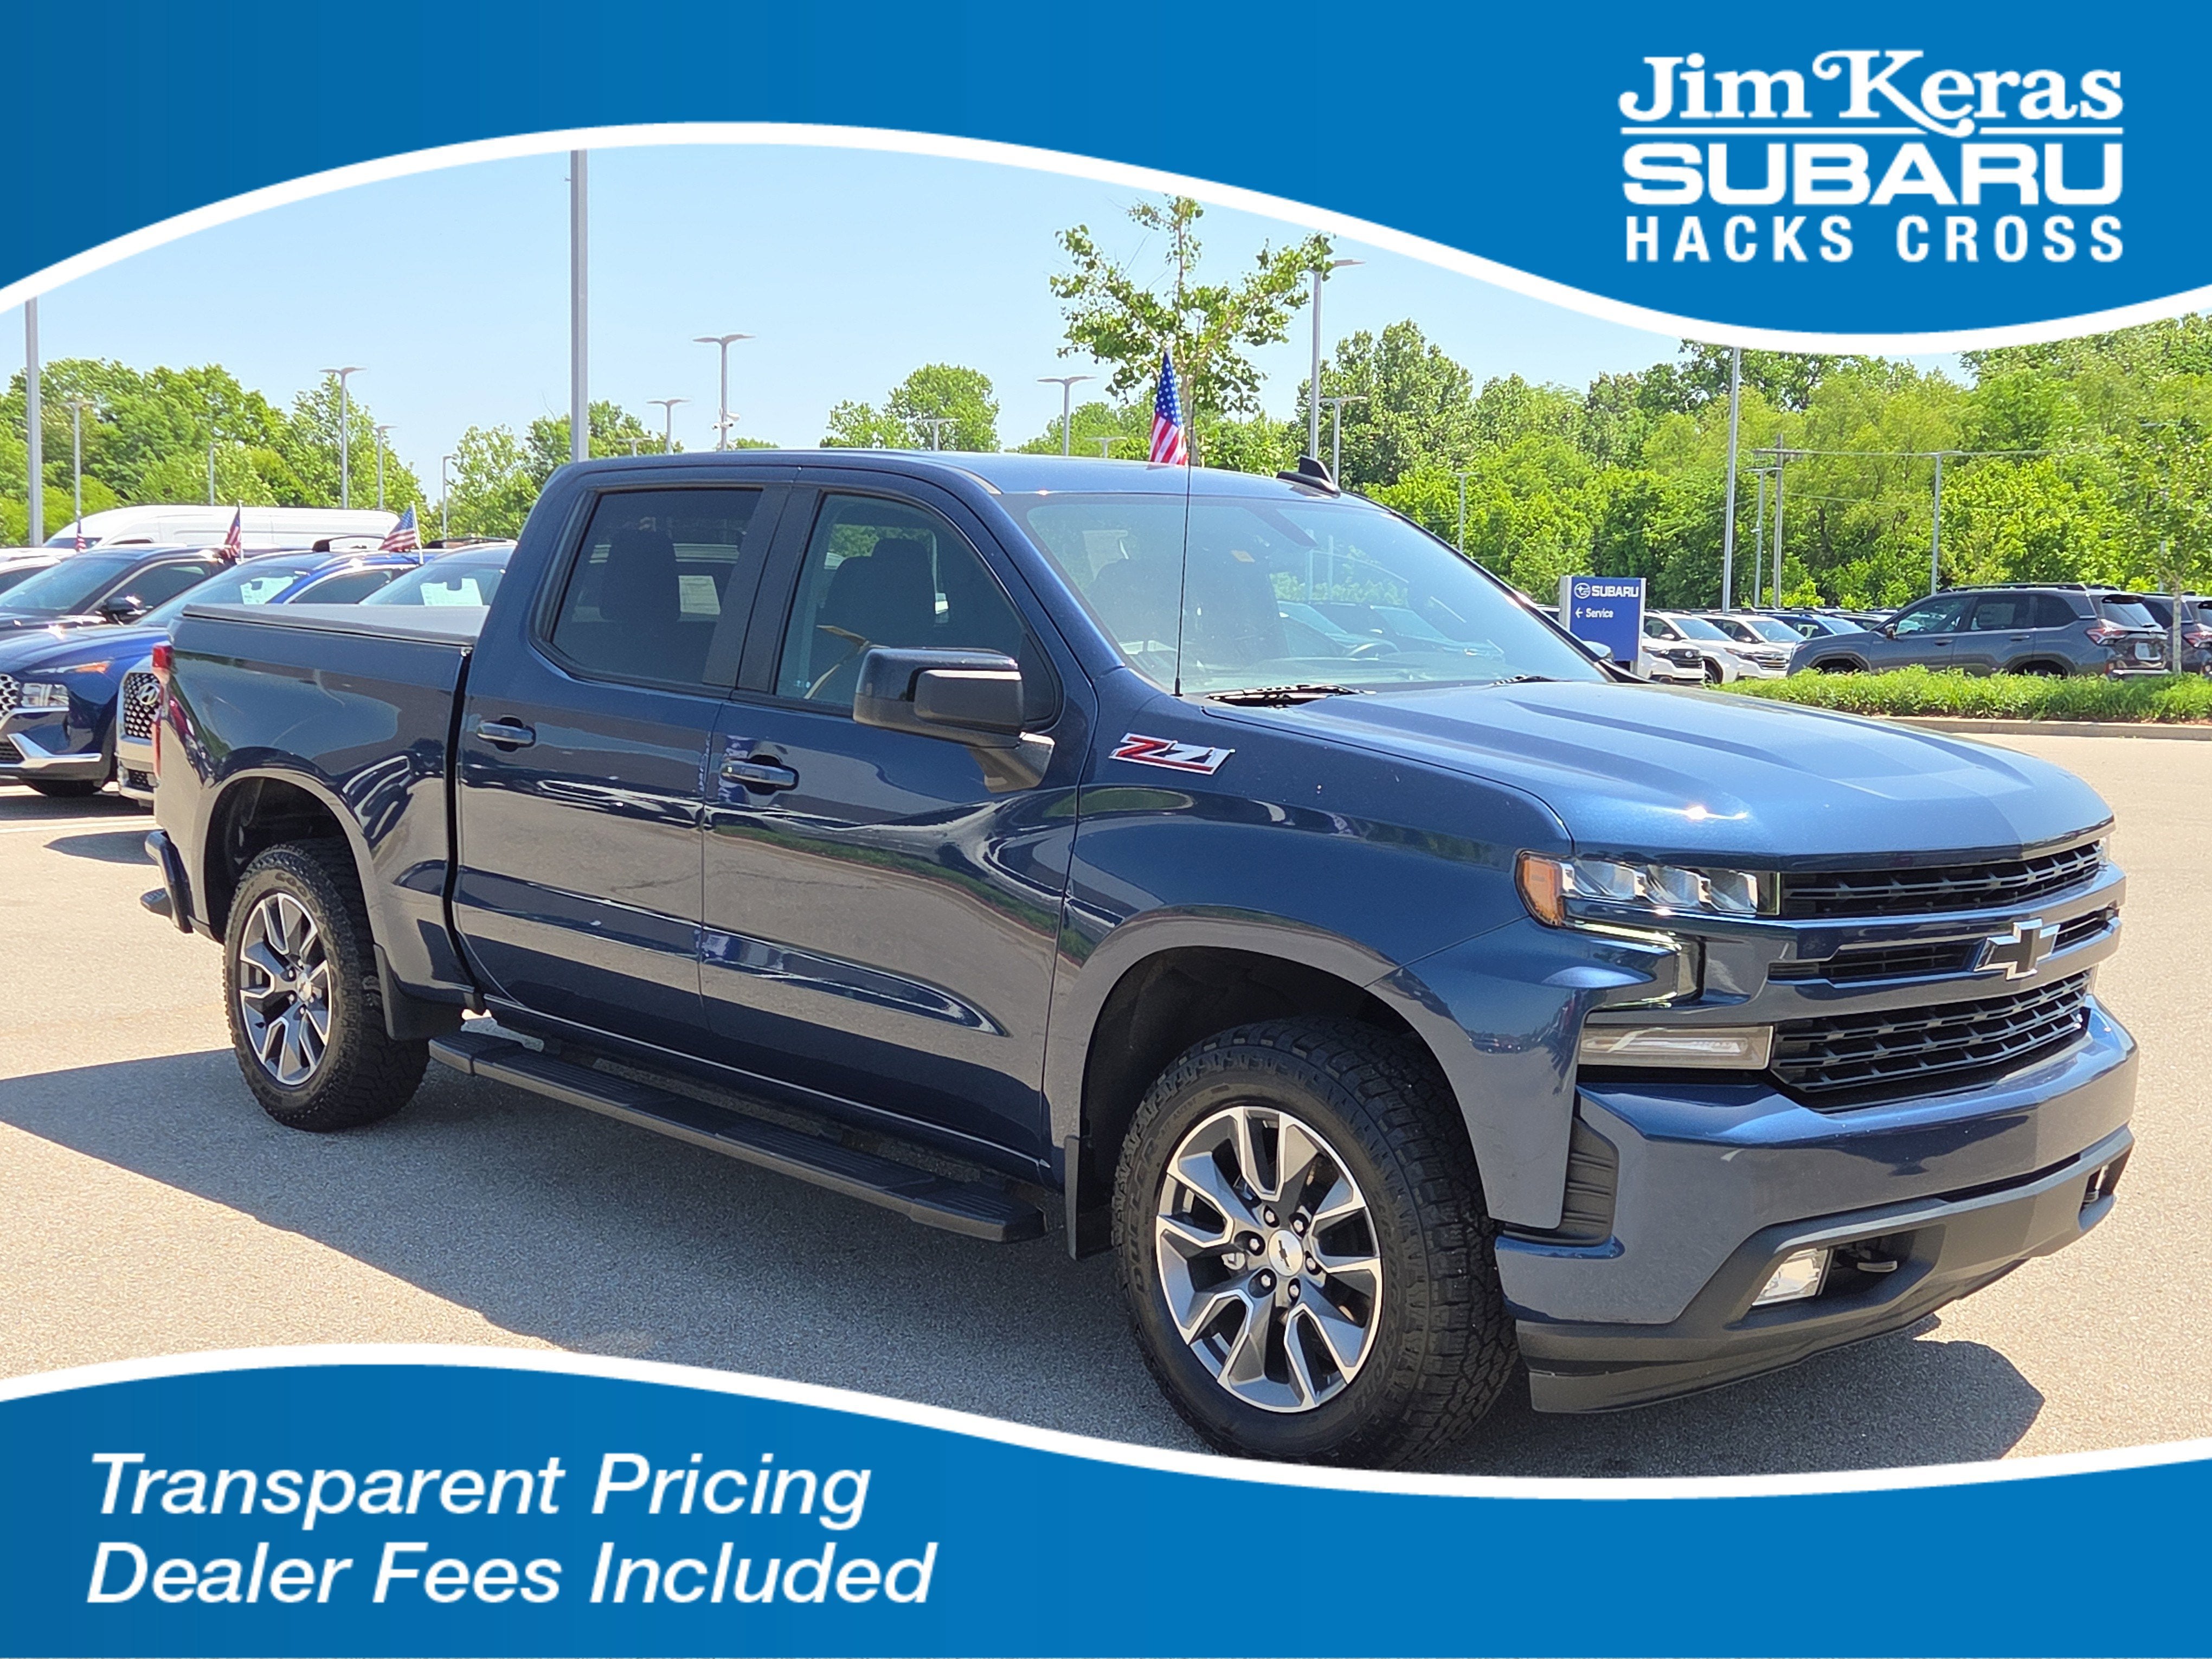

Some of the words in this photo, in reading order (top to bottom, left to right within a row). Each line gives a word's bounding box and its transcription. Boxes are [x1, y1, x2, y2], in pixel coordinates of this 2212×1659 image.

[1591, 586, 1639, 597] SUBARU
[1586, 608, 1613, 618] Service
[1109, 732, 1236, 775] Z71
